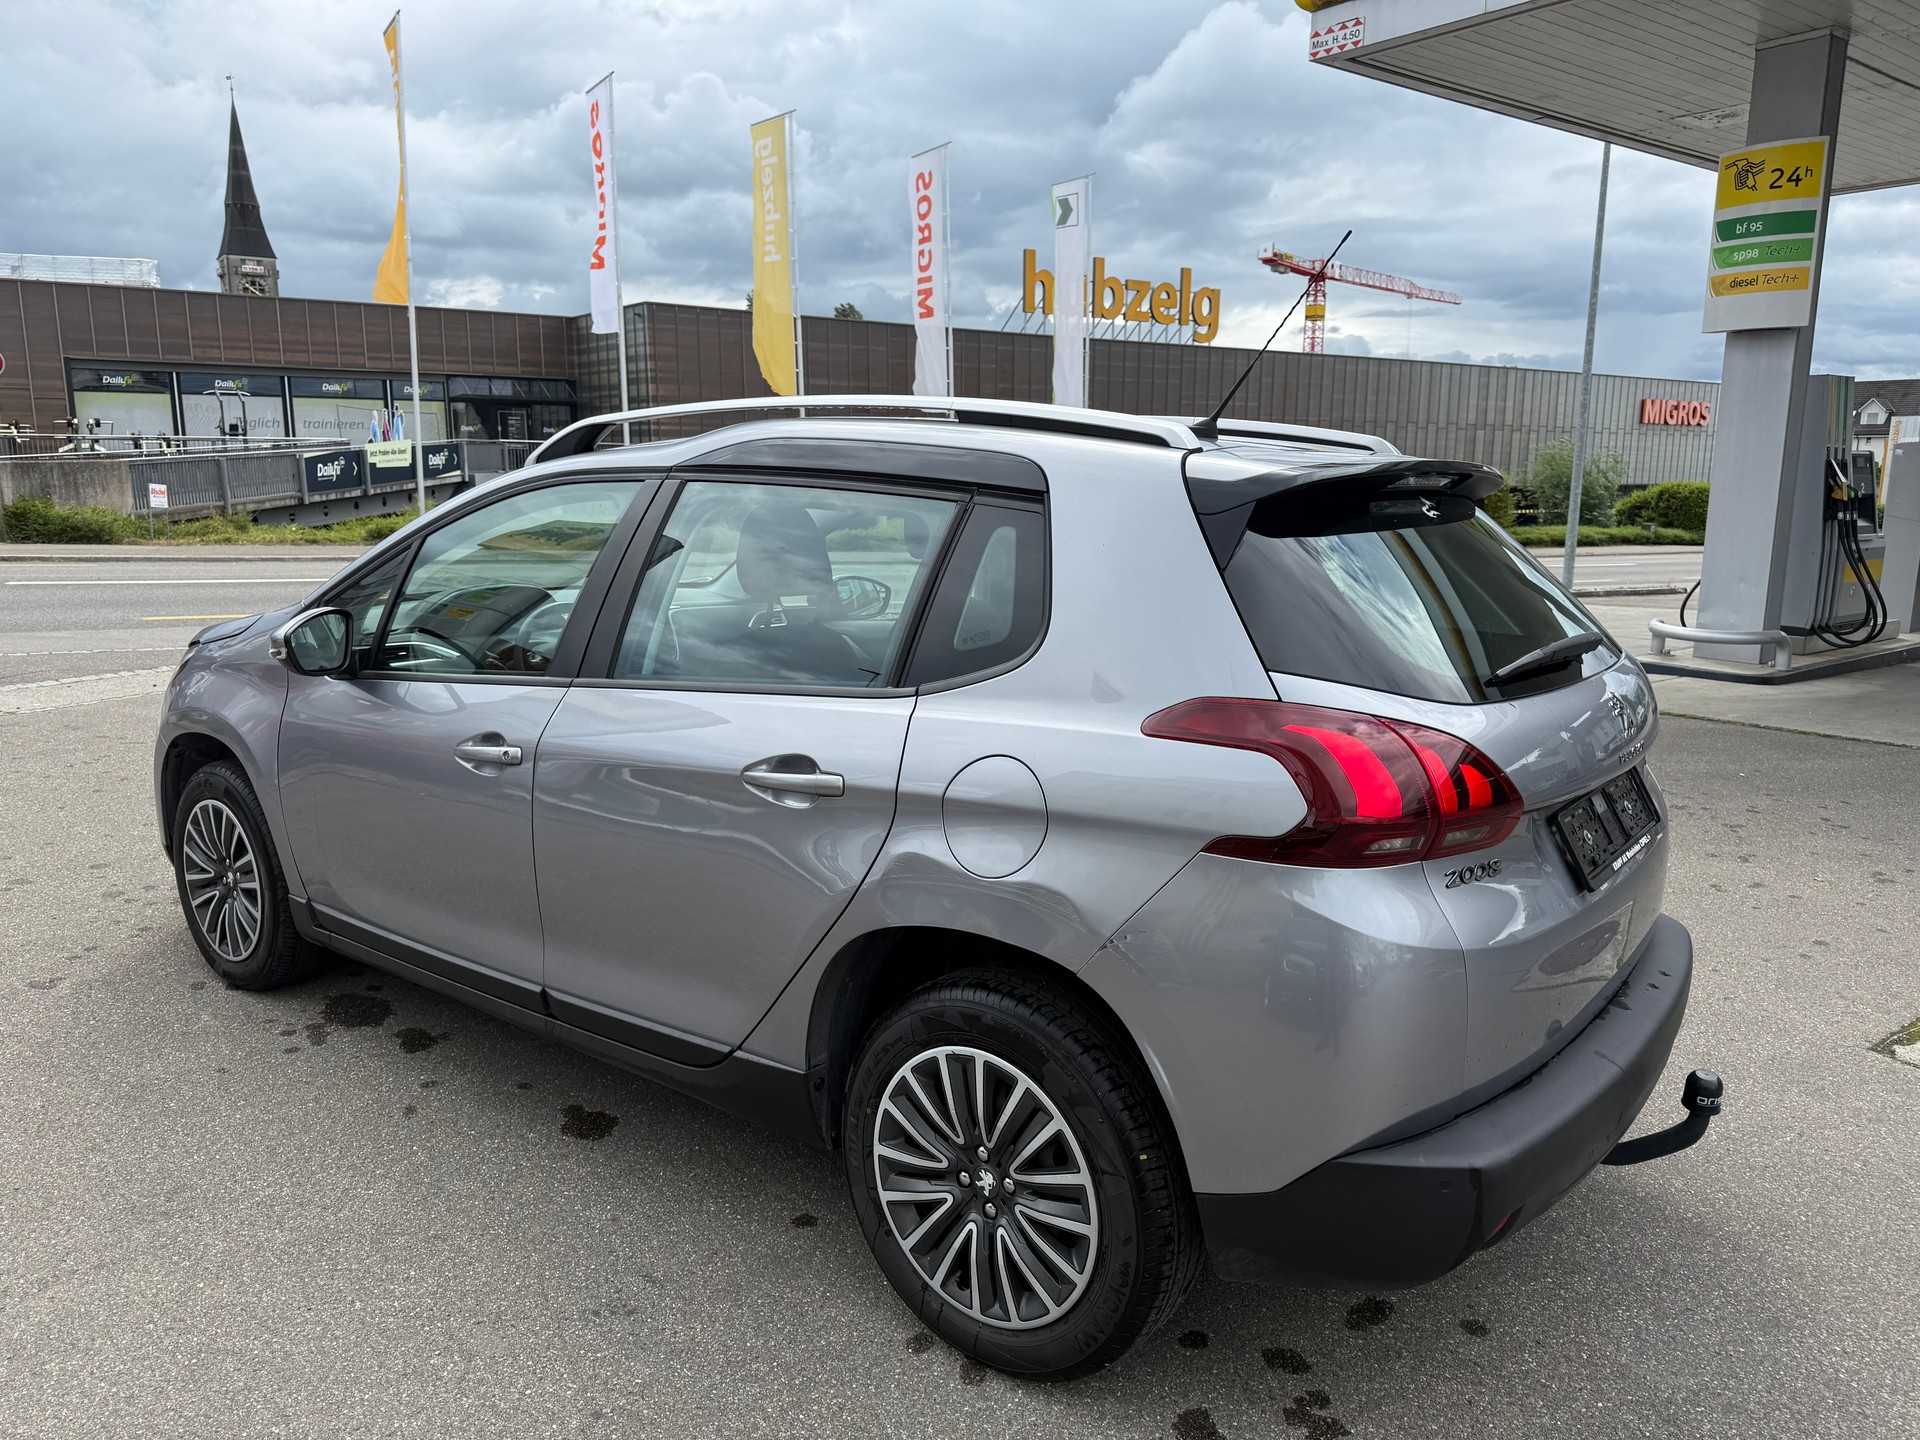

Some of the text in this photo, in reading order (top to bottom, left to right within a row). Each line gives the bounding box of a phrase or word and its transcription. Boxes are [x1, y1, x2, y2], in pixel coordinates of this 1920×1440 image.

[1312, 39, 1329, 50] Max
[1342, 29, 1360, 41] 4.50
[1736, 221, 1763, 234] bf 95
[1733, 244, 1803, 262] sp98 Tech+
[1729, 273, 1800, 288] diesel Tech+
[1023, 248, 1221, 343] hbzelg
[1641, 398, 1711, 426] MIGROS
[1860, 482, 1866, 494] 2
[1444, 858, 1502, 889] 2008
